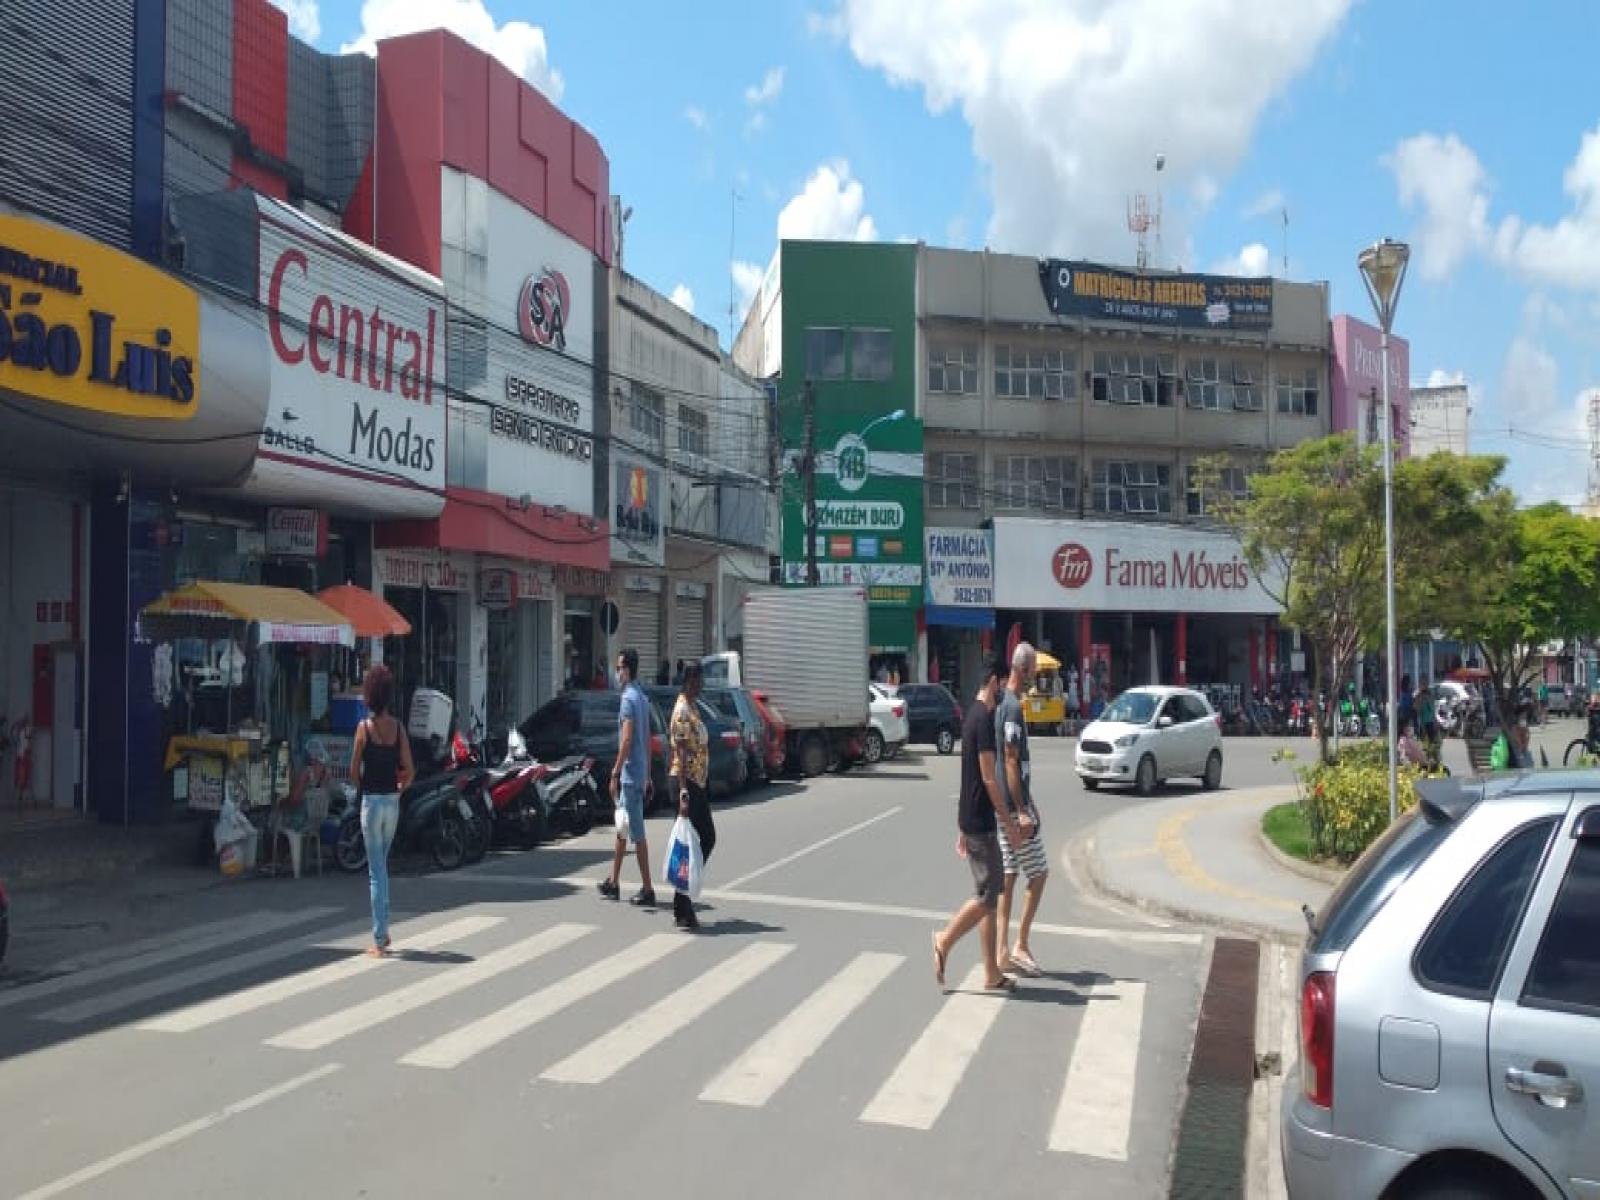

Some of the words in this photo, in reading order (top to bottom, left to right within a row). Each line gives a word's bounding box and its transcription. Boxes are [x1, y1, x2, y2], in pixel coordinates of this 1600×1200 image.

[87, 309, 194, 404] Luis
[268, 248, 436, 405] Central
[349, 401, 435, 472] Modas
[929, 534, 986, 558] FARMÁCIA
[1105, 548, 1167, 588] Fama
[1171, 549, 1249, 589] Móveis
